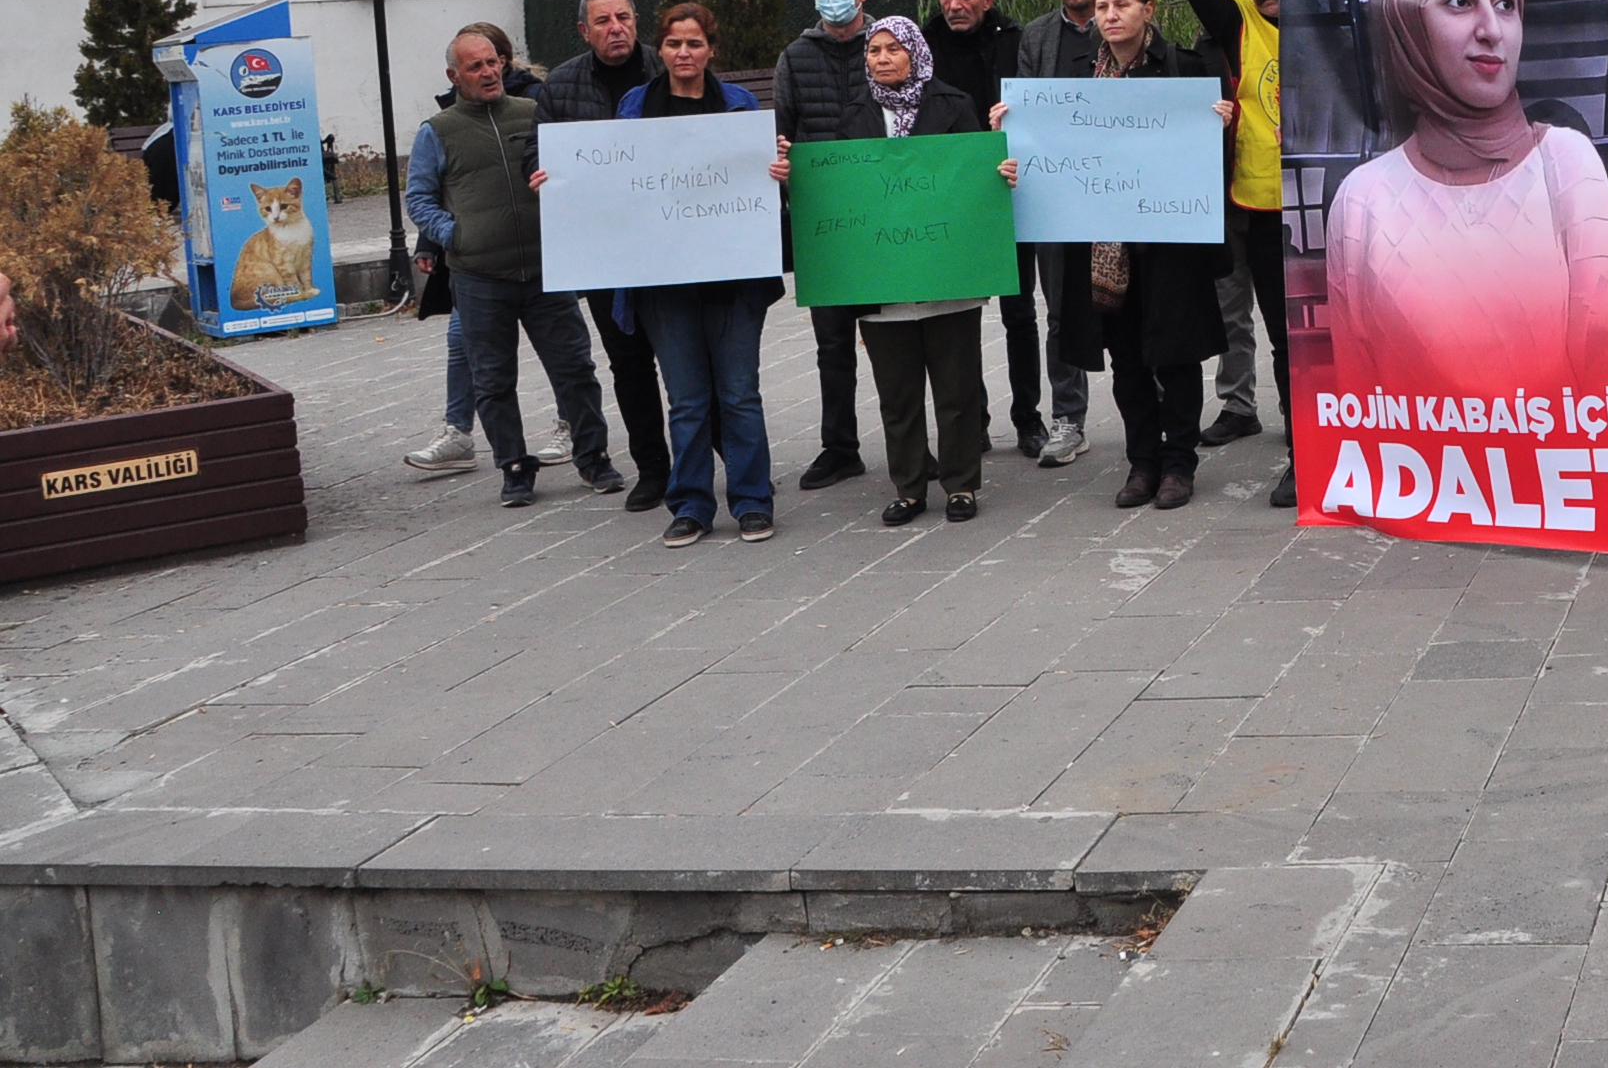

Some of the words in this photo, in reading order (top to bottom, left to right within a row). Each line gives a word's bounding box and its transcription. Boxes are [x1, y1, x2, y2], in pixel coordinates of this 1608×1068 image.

[213, 106, 242, 117] KARS
[244, 98, 306, 114] BELEDİYESİ
[220, 135, 259, 148] Sadece
[261, 133, 269, 143] 1
[272, 131, 286, 142] TL
[217, 150, 246, 161] Minik
[248, 144, 310, 159] Dostlarımızı
[575, 142, 636, 166] ROJİN
[218, 156, 308, 175] Doyurabilirsiniz
[1023, 155, 1102, 176] ADALET
[879, 174, 936, 199] YARGI
[1074, 168, 1142, 194] YERİNİ
[814, 209, 866, 236] ETKİN
[875, 222, 949, 246] ADALET
[1316, 385, 1411, 430] ROJİN
[1415, 387, 1555, 442] KABAİŞ
[46, 471, 102, 497] KARS
[107, 453, 194, 486] VALİLİĞİ
